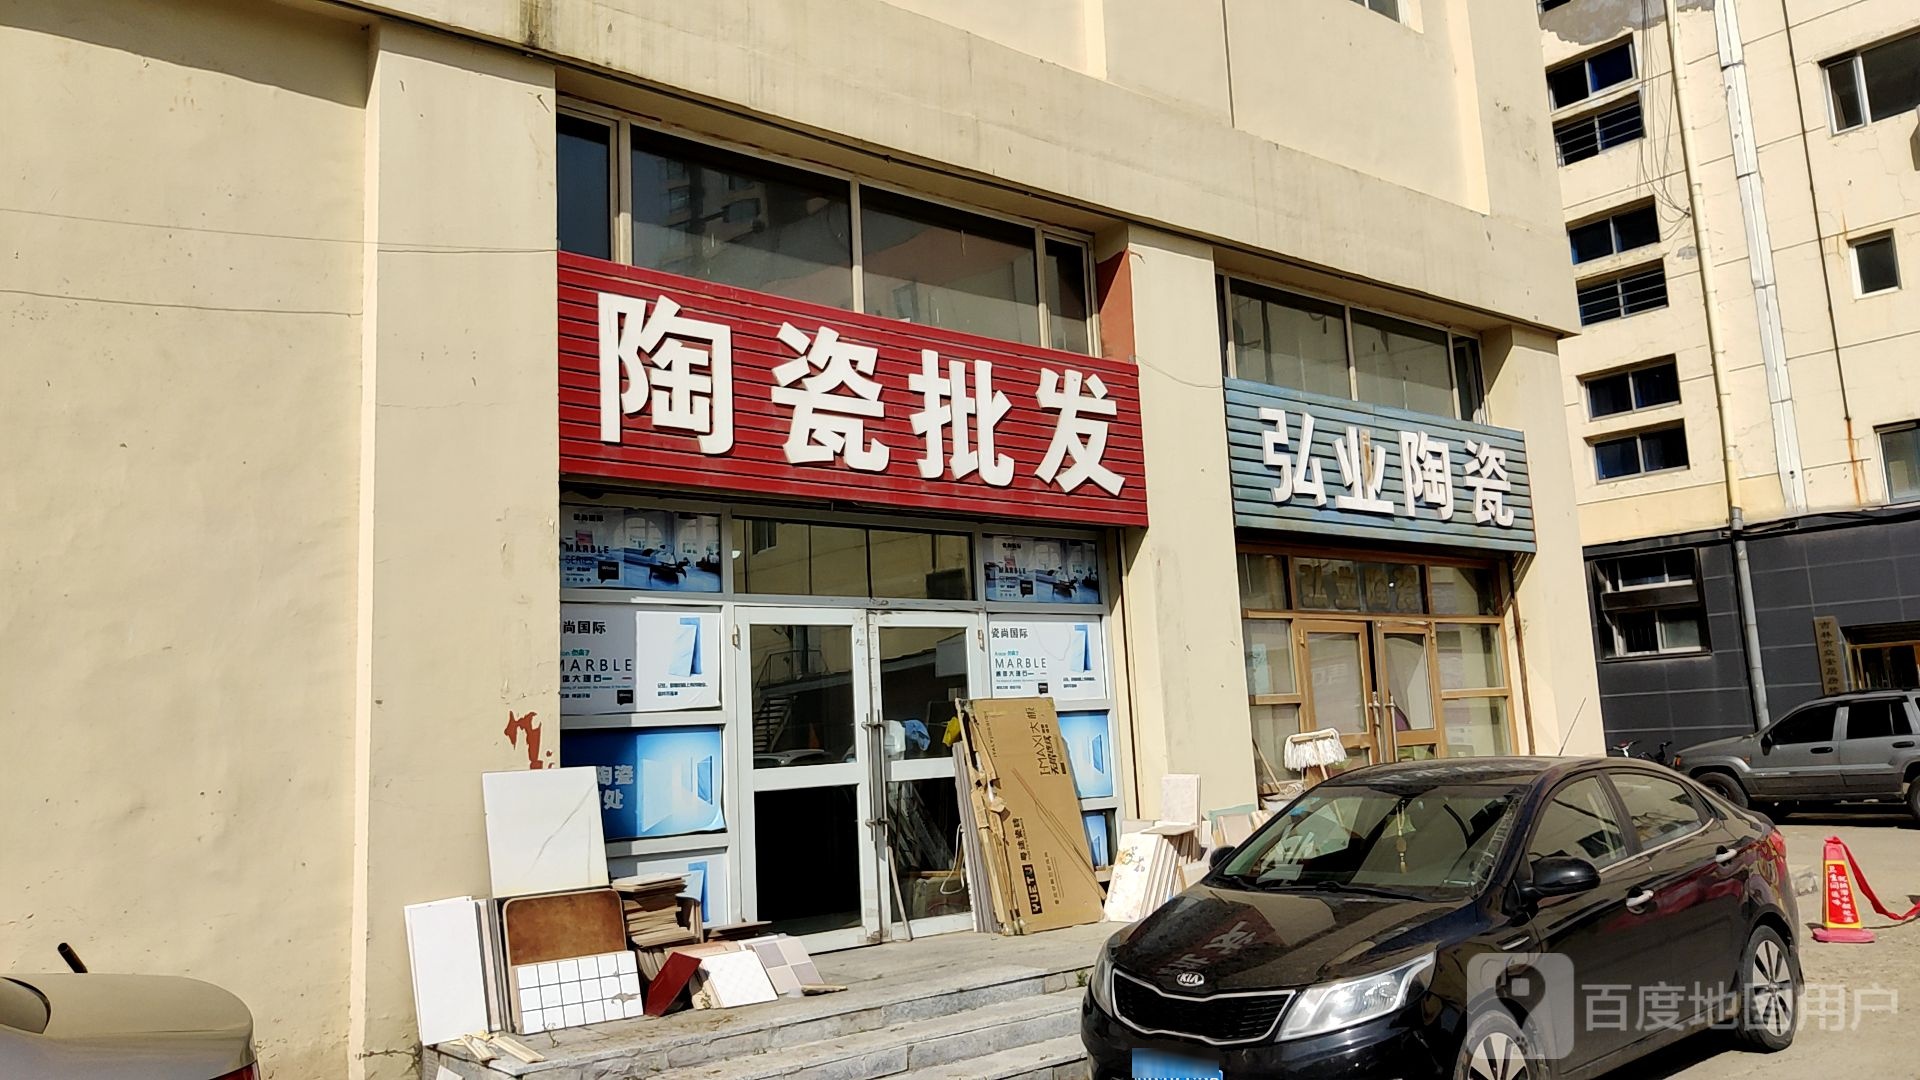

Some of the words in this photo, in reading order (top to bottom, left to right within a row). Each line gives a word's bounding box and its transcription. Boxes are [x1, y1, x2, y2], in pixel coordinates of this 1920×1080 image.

[597, 291, 1126, 496] 陶瓷批发
[1259, 407, 1514, 527] 弘业陶瓷
[565, 543, 610, 553] MARBLE
[991, 627, 1029, 639] 瓷尚国际
[995, 657, 1047, 669] MARBLE
[1179, 972, 1200, 983] KIA
